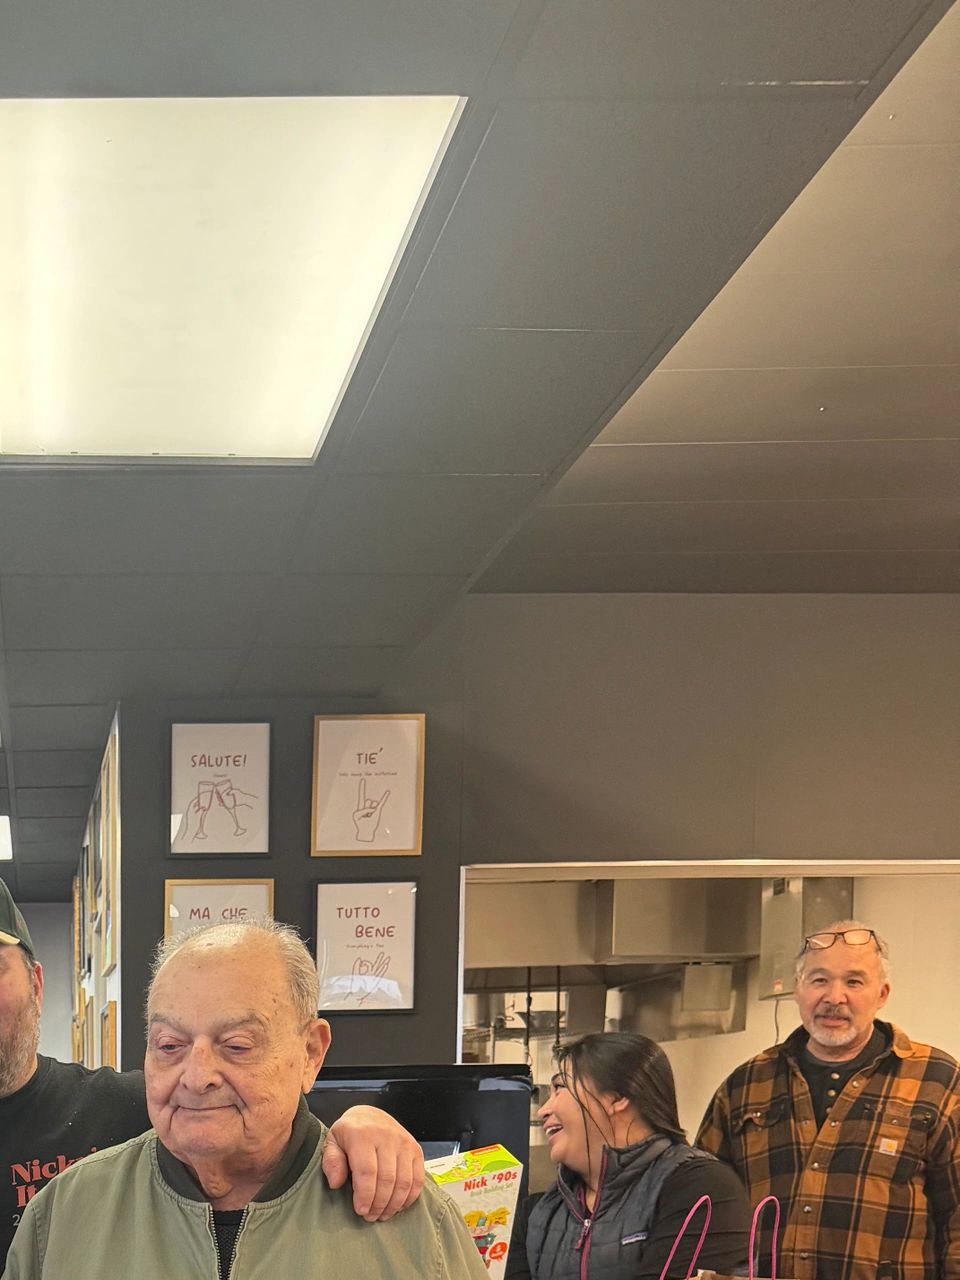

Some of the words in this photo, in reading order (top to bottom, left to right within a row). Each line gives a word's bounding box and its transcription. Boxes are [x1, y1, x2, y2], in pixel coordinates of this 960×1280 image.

[191, 754, 247, 768] SALUTE!
[189, 907, 210, 920] MA
[336, 906, 381, 919] TUTTO
[355, 924, 396, 938] BENE
[464, 1176, 488, 1191] Nick
